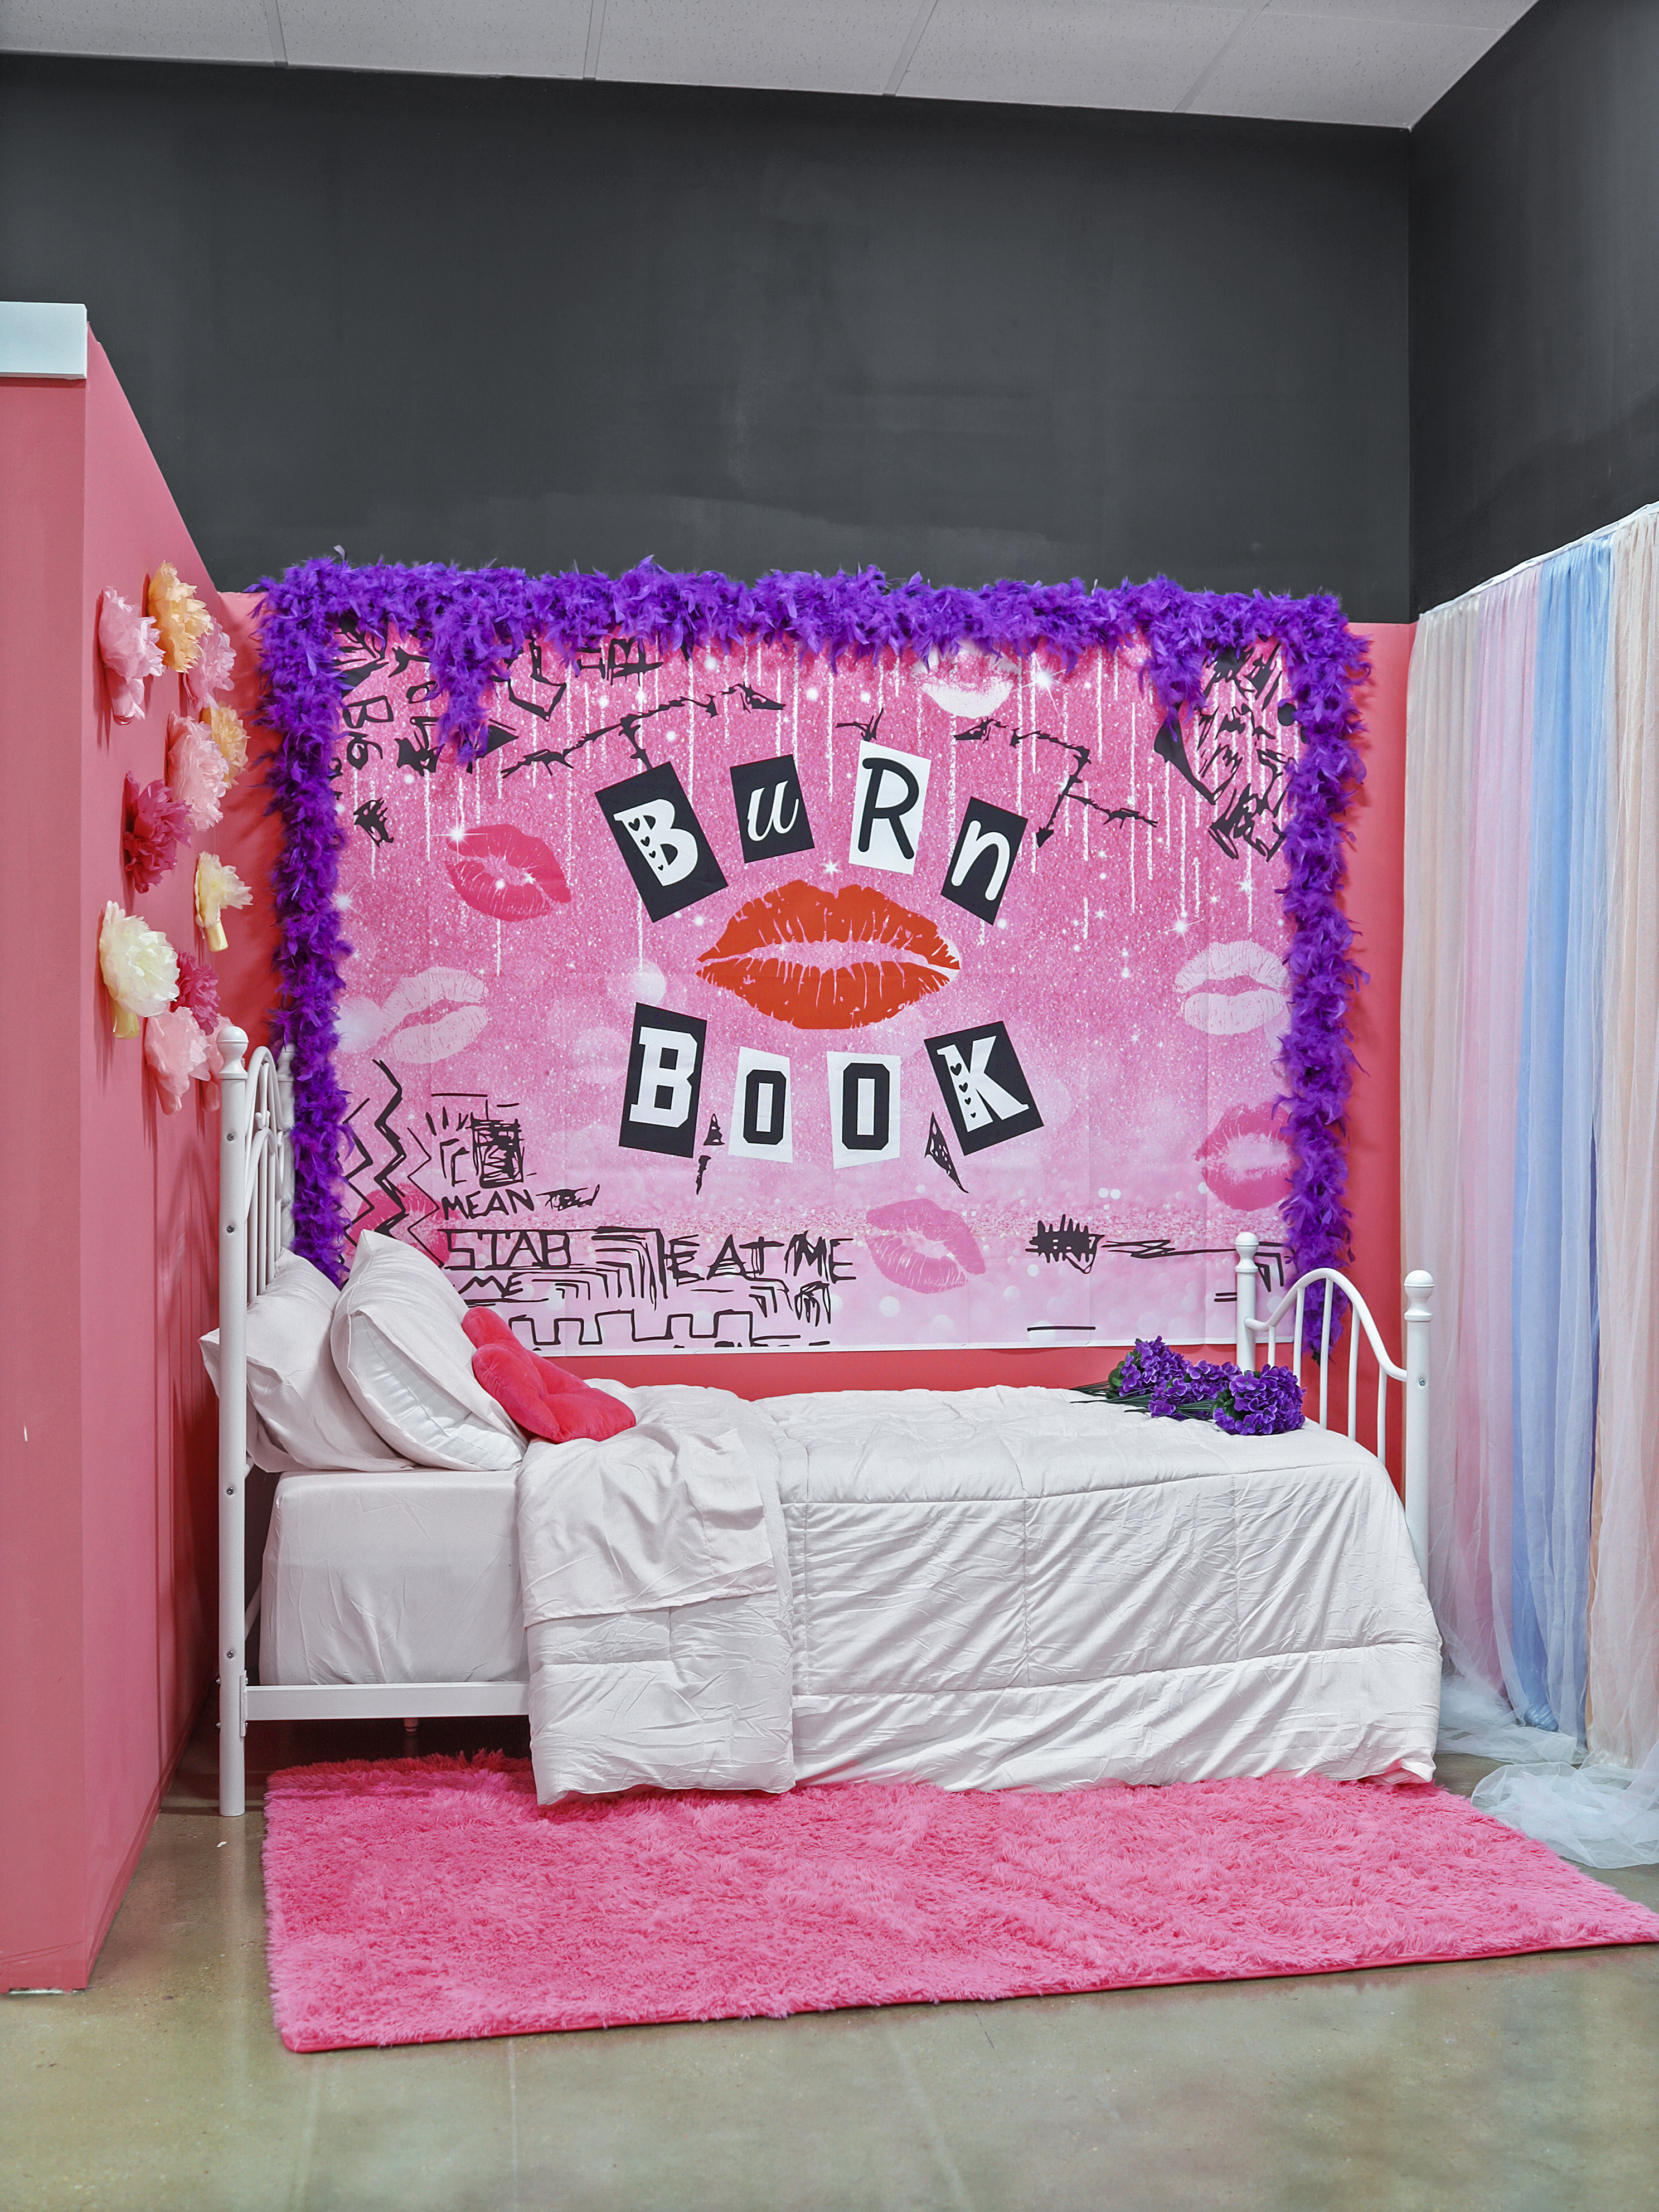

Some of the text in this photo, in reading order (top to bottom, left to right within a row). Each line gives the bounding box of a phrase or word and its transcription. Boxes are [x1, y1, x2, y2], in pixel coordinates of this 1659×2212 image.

[628, 1025, 1030, 1151] BOOK
[441, 1188, 535, 1221] MEAN
[444, 1229, 571, 1270] STAB
[457, 1272, 523, 1299] ME
